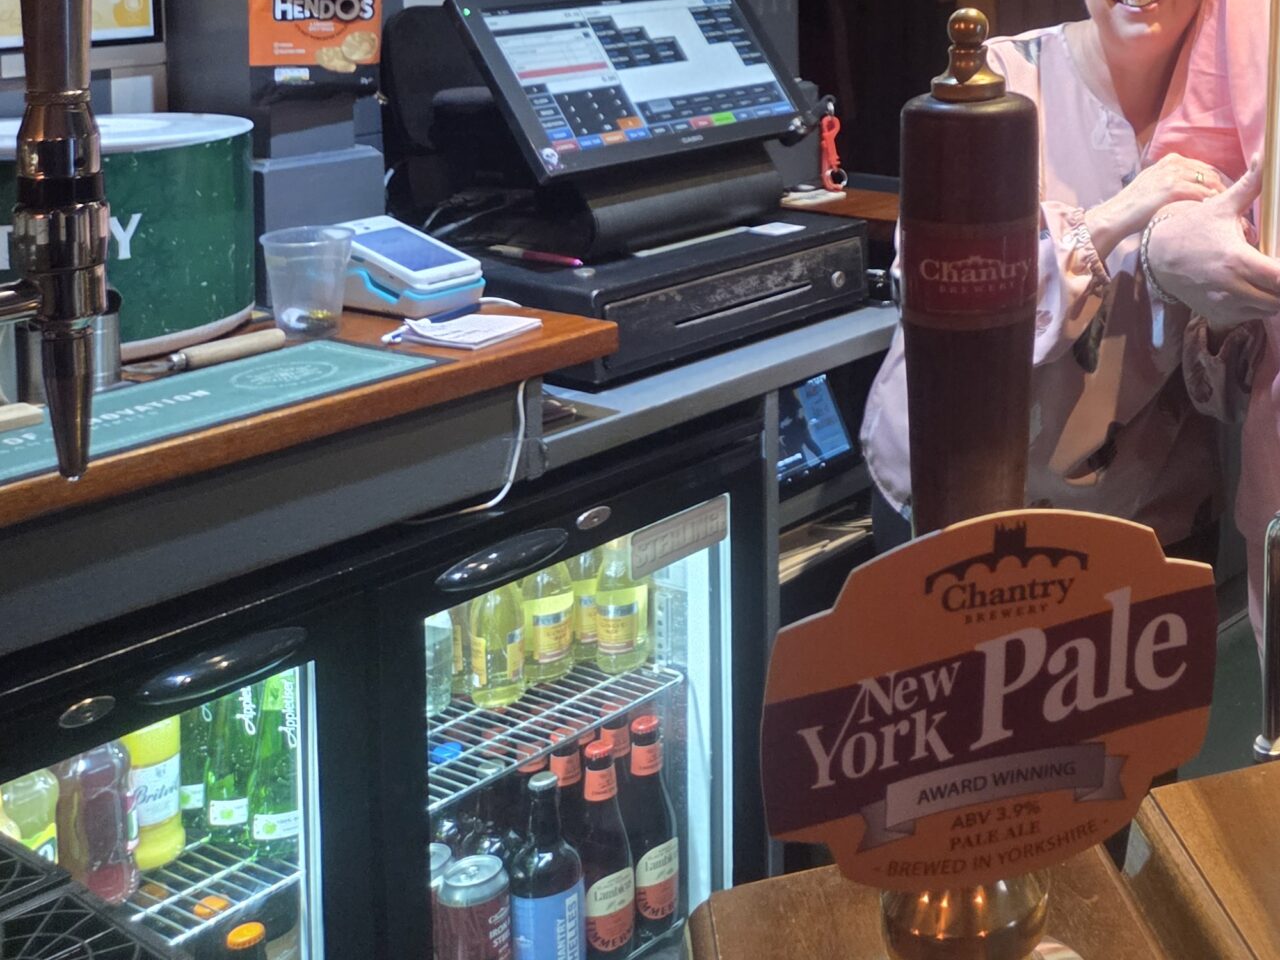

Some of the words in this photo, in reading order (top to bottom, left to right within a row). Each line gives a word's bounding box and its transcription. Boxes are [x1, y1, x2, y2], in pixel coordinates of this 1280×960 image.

[919, 258, 1031, 282] Chantry
[941, 573, 1075, 613] Chantry
[964, 602, 1050, 625] BREWERY
[969, 586, 1189, 752] Pale
[857, 660, 962, 725] New
[798, 700, 955, 790] York
[917, 776, 988, 806] AWARD
[992, 760, 1077, 788] WINNING
[949, 830, 999, 852] PALE
[1005, 819, 1041, 842] ALE
[950, 812, 992, 831] ABV
[995, 800, 1041, 821] 3.9%
[887, 858, 967, 878] BREWED
[973, 855, 992, 873] IN
[997, 819, 1099, 867] YORKSHIRE
